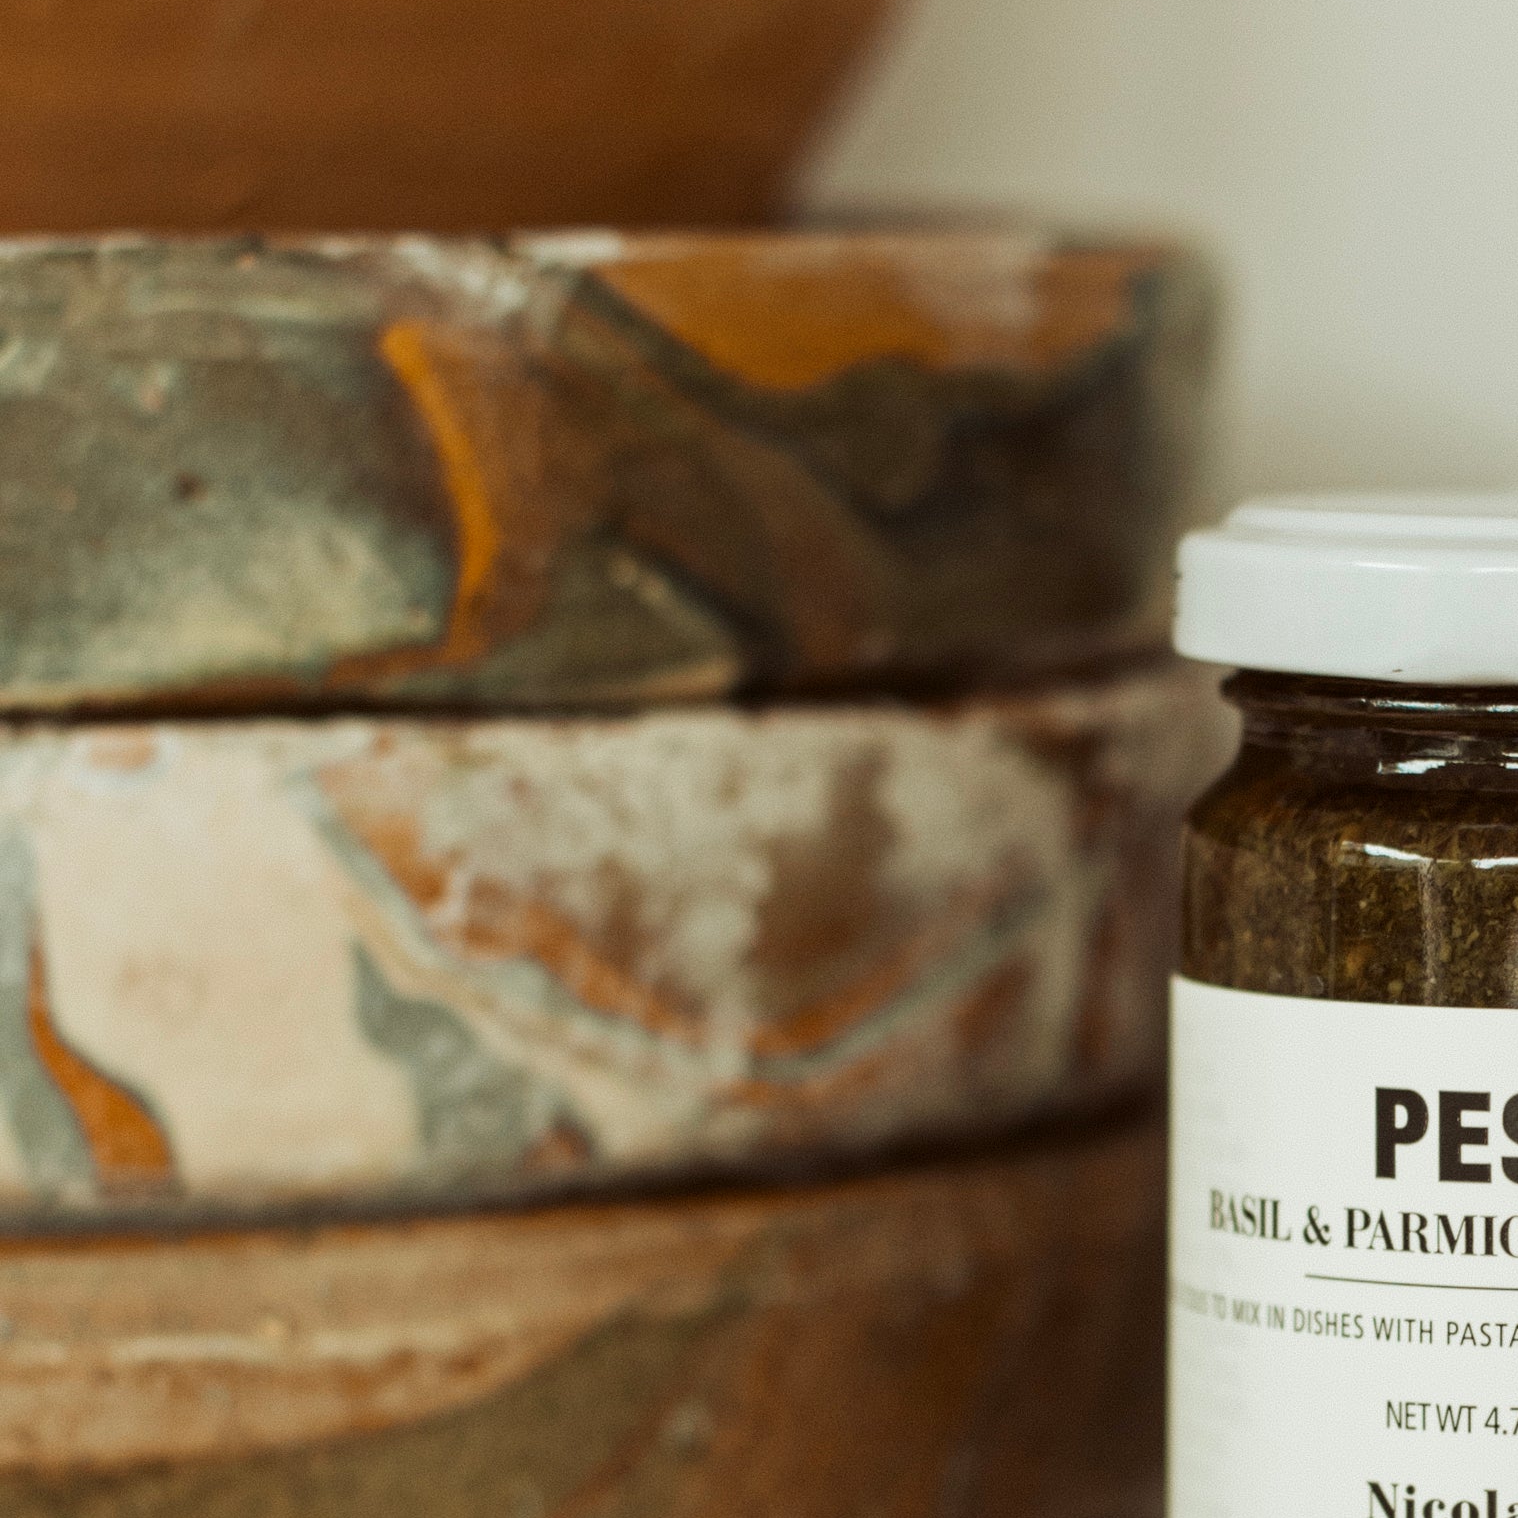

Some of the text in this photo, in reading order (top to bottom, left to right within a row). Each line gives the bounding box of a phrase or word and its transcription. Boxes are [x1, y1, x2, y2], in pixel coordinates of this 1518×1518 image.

[1209, 1189, 1292, 1242] BASIL
[1301, 1204, 1331, 1247] &
[1230, 1298, 1261, 1327] MIX
[1265, 1304, 1286, 1331] IN
[1292, 1307, 1365, 1340] DISHES
[1371, 1316, 1434, 1345] WITH
[1385, 1399, 1432, 1431] NET
[1434, 1403, 1478, 1434] WT
